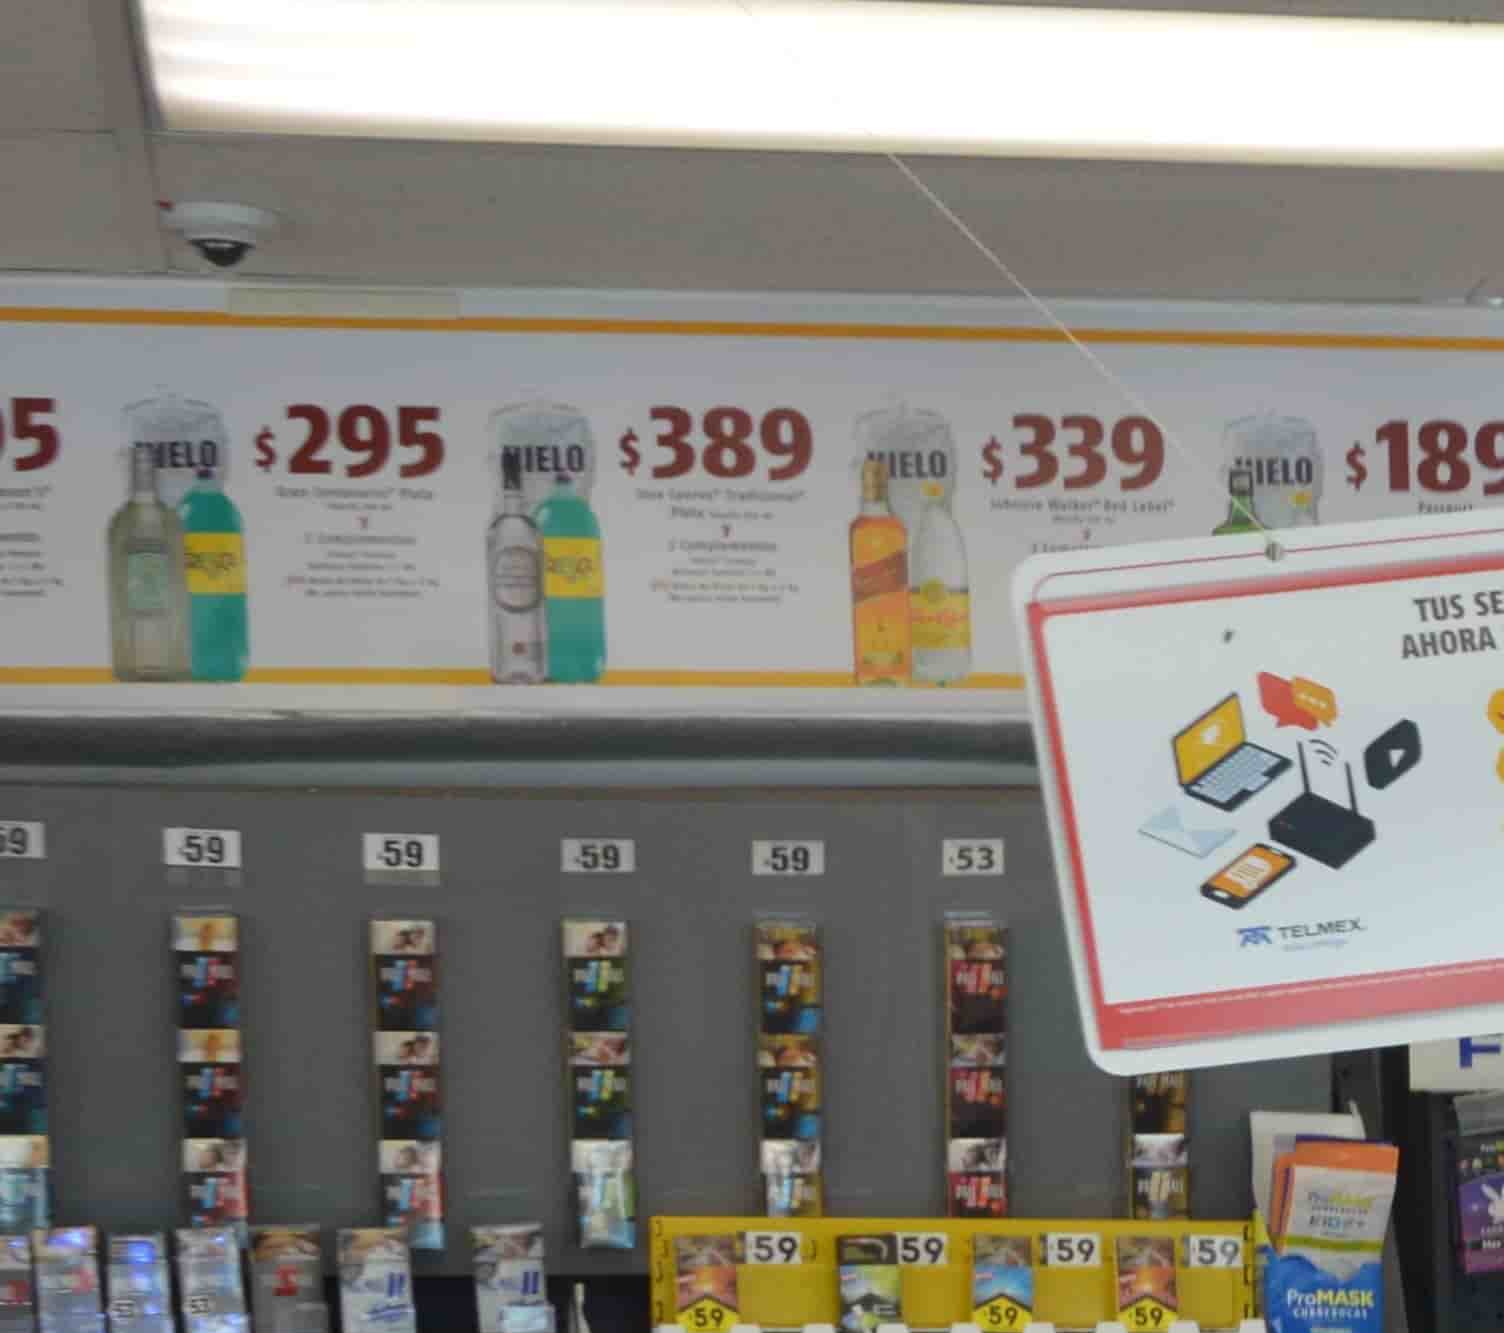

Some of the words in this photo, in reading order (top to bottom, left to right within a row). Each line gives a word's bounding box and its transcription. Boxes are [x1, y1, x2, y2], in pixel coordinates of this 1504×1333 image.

[254, 403, 446, 478] $295
[618, 404, 813, 482] $389
[982, 412, 1166, 492] $339
[1412, 595, 1465, 624] TUS
[1401, 625, 1497, 660] AHORA
[1277, 916, 1362, 940] TELMEX
[1287, 1288, 1375, 1308] ProMASK
